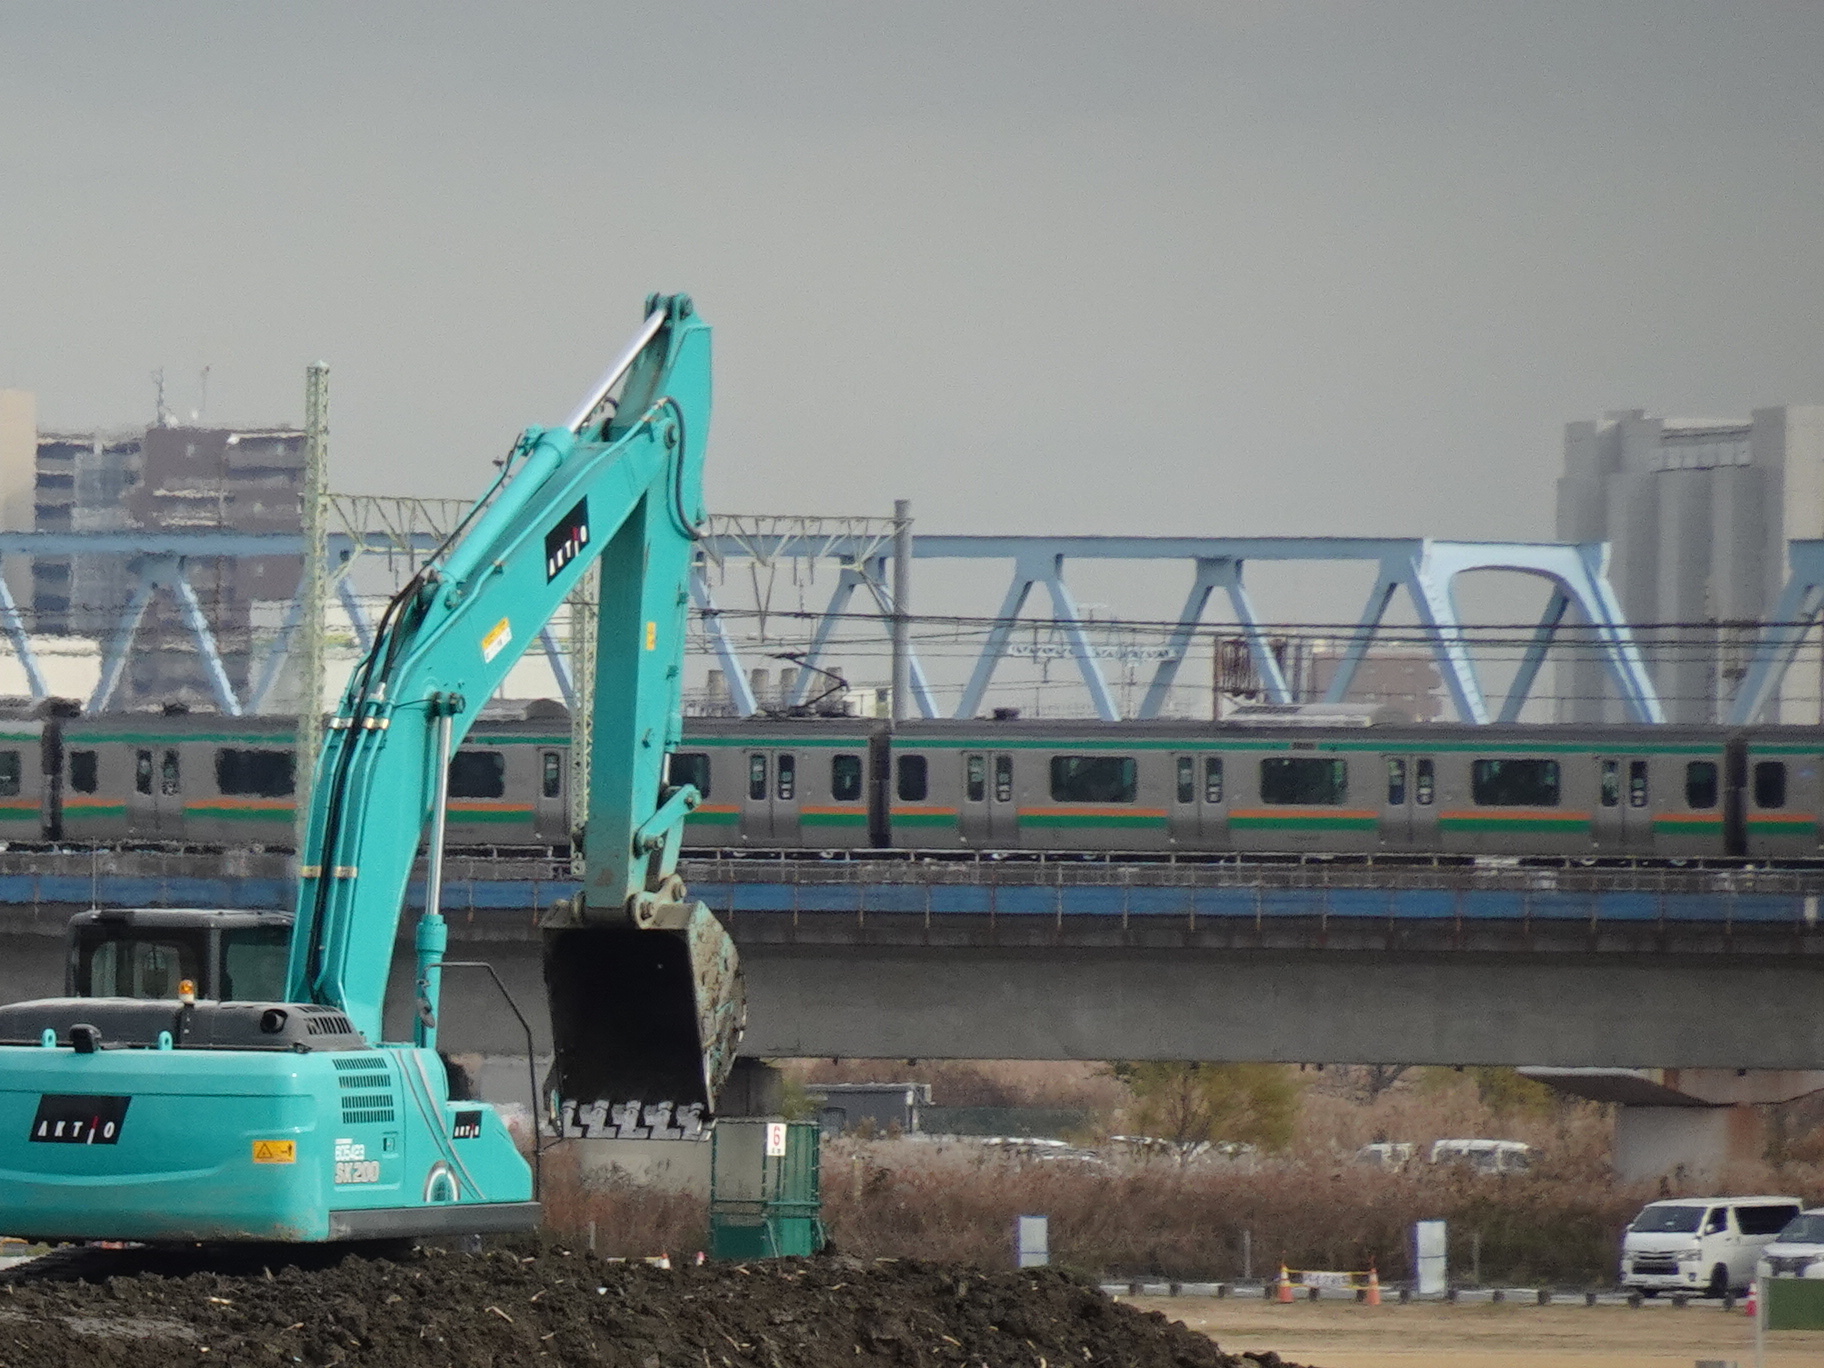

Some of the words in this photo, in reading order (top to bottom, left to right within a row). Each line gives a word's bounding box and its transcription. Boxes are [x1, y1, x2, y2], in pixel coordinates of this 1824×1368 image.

[37, 1115, 116, 1145] AKTIO
[773, 1125, 781, 1147] 6
[334, 1161, 380, 1184] SK200
